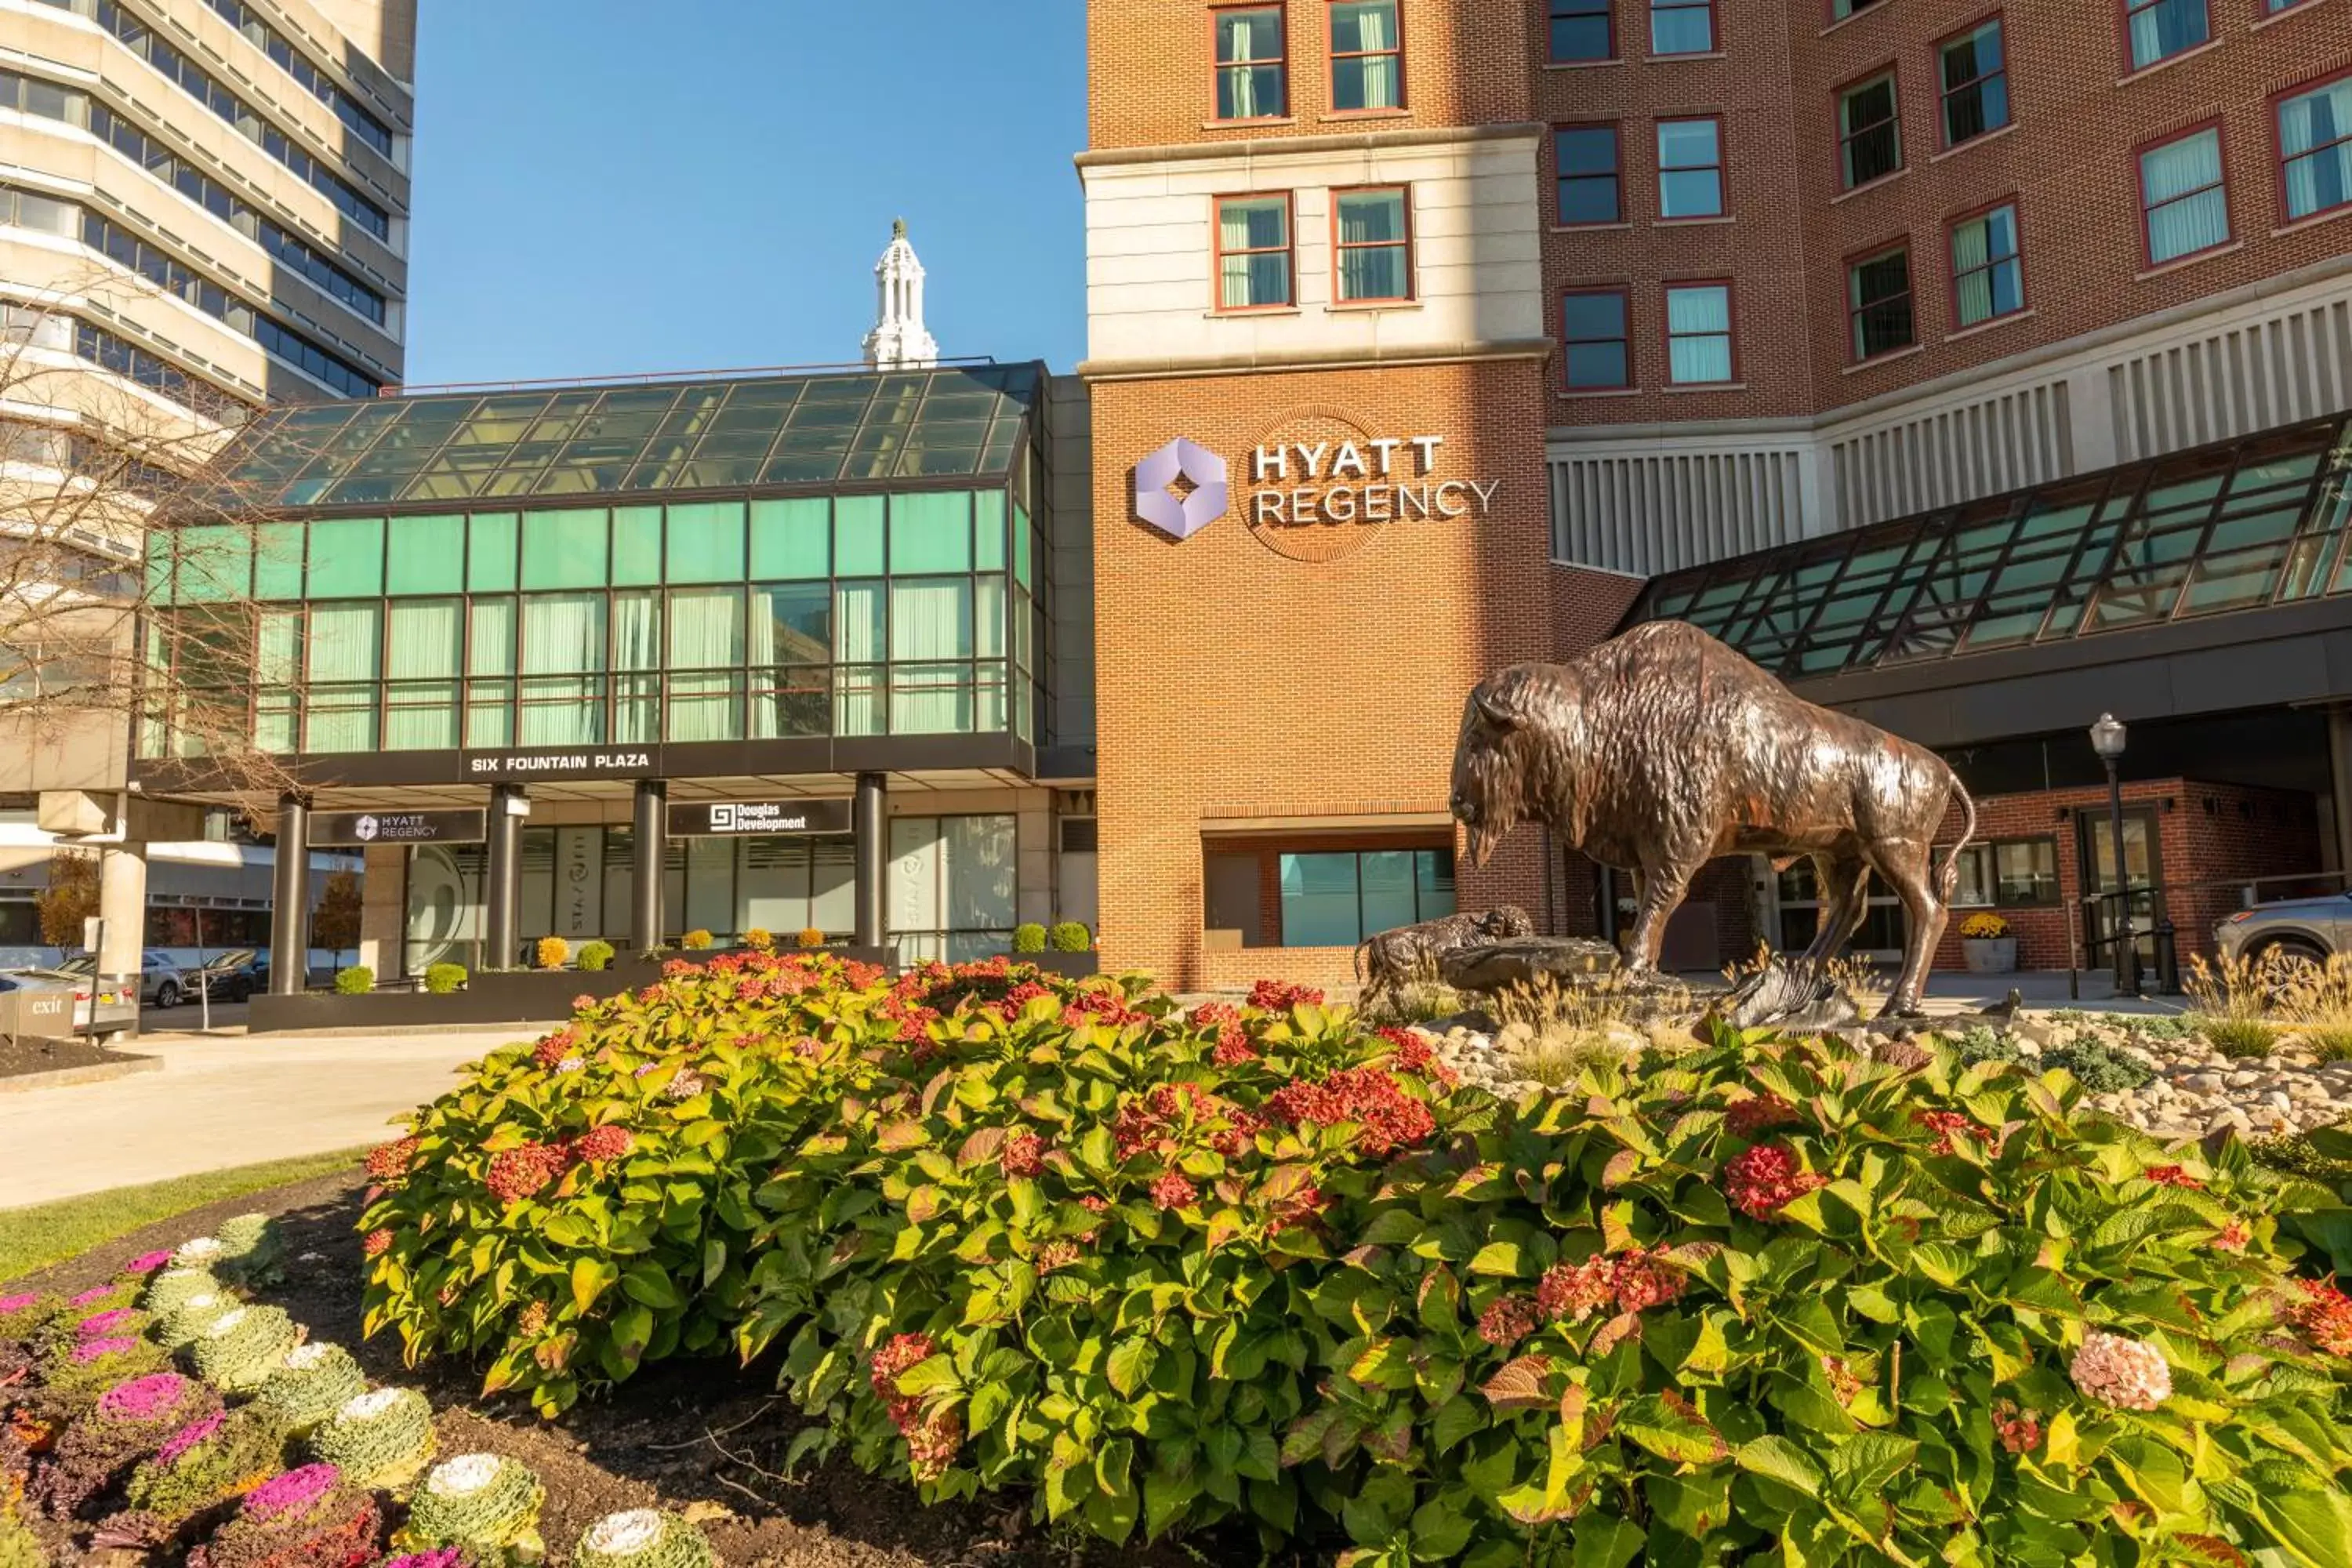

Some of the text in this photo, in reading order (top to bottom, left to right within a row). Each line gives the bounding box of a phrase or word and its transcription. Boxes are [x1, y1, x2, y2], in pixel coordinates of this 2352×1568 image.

[1256, 436, 1443, 479] HYATT
[1258, 479, 1500, 524] REGENCY
[472, 753, 649, 771] SIX FOUNTAIN PLAZA
[738, 803, 780, 818] Douglas
[382, 815, 424, 826] HYATT
[738, 815, 805, 832] Development
[382, 826, 437, 837] REGENCY
[32, 996, 62, 1014] exit
